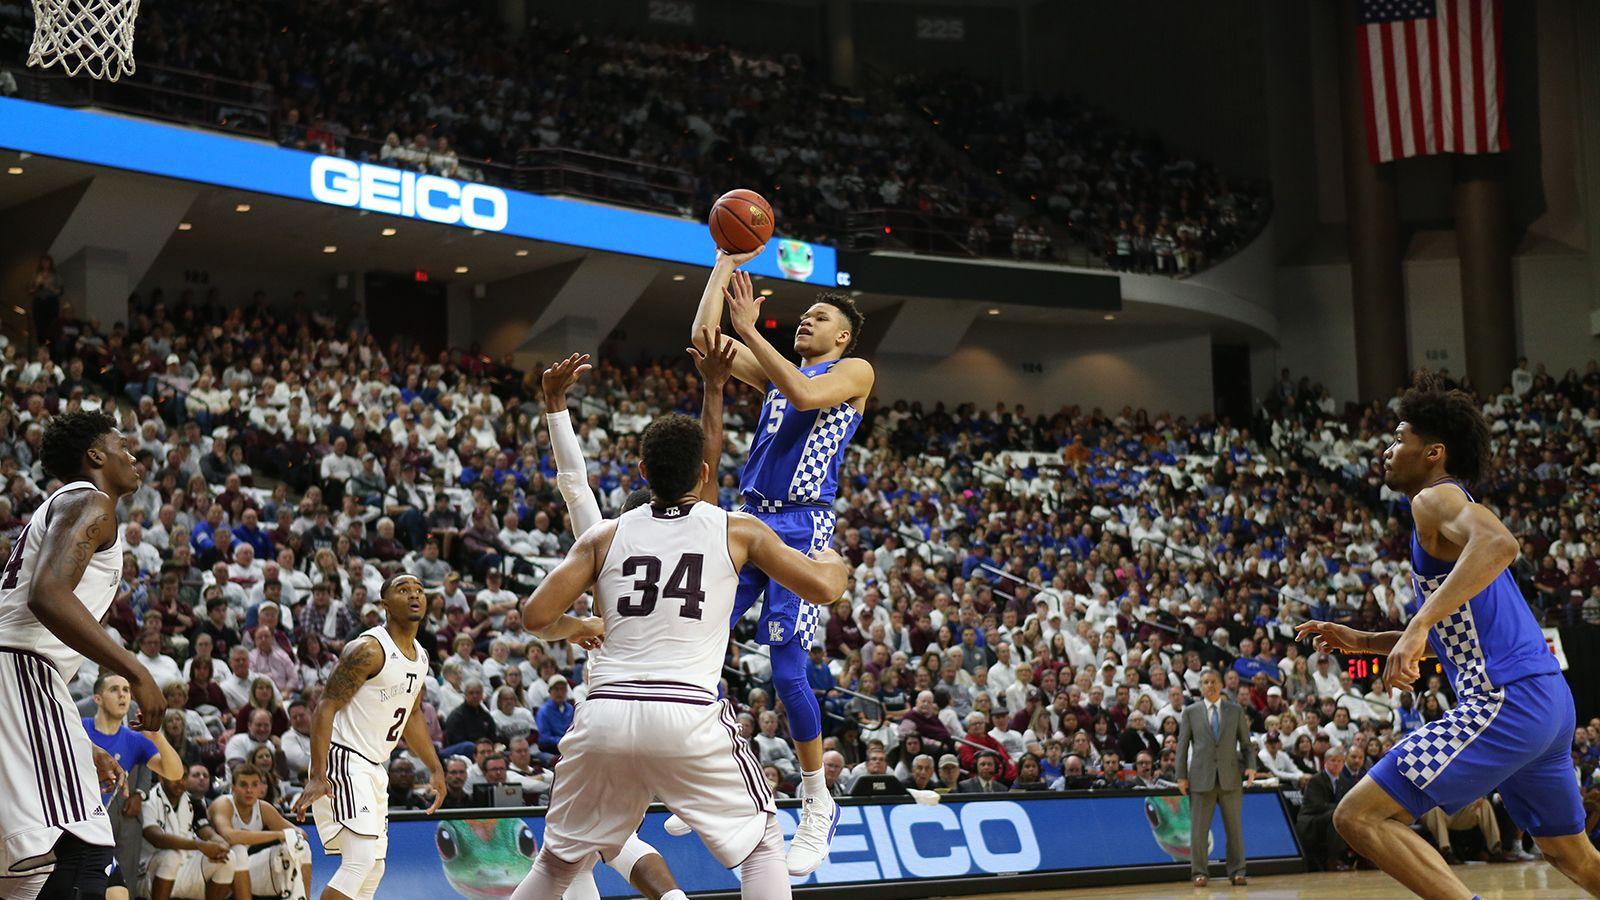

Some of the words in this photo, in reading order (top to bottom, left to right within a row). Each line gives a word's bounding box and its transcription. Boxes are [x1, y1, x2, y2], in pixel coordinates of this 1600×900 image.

[648, 1, 693, 25] 224
[916, 17, 964, 40] 225
[310, 156, 508, 231] GEICO
[767, 398, 787, 433] 5
[617, 552, 705, 621] 34
[386, 707, 407, 742] 2
